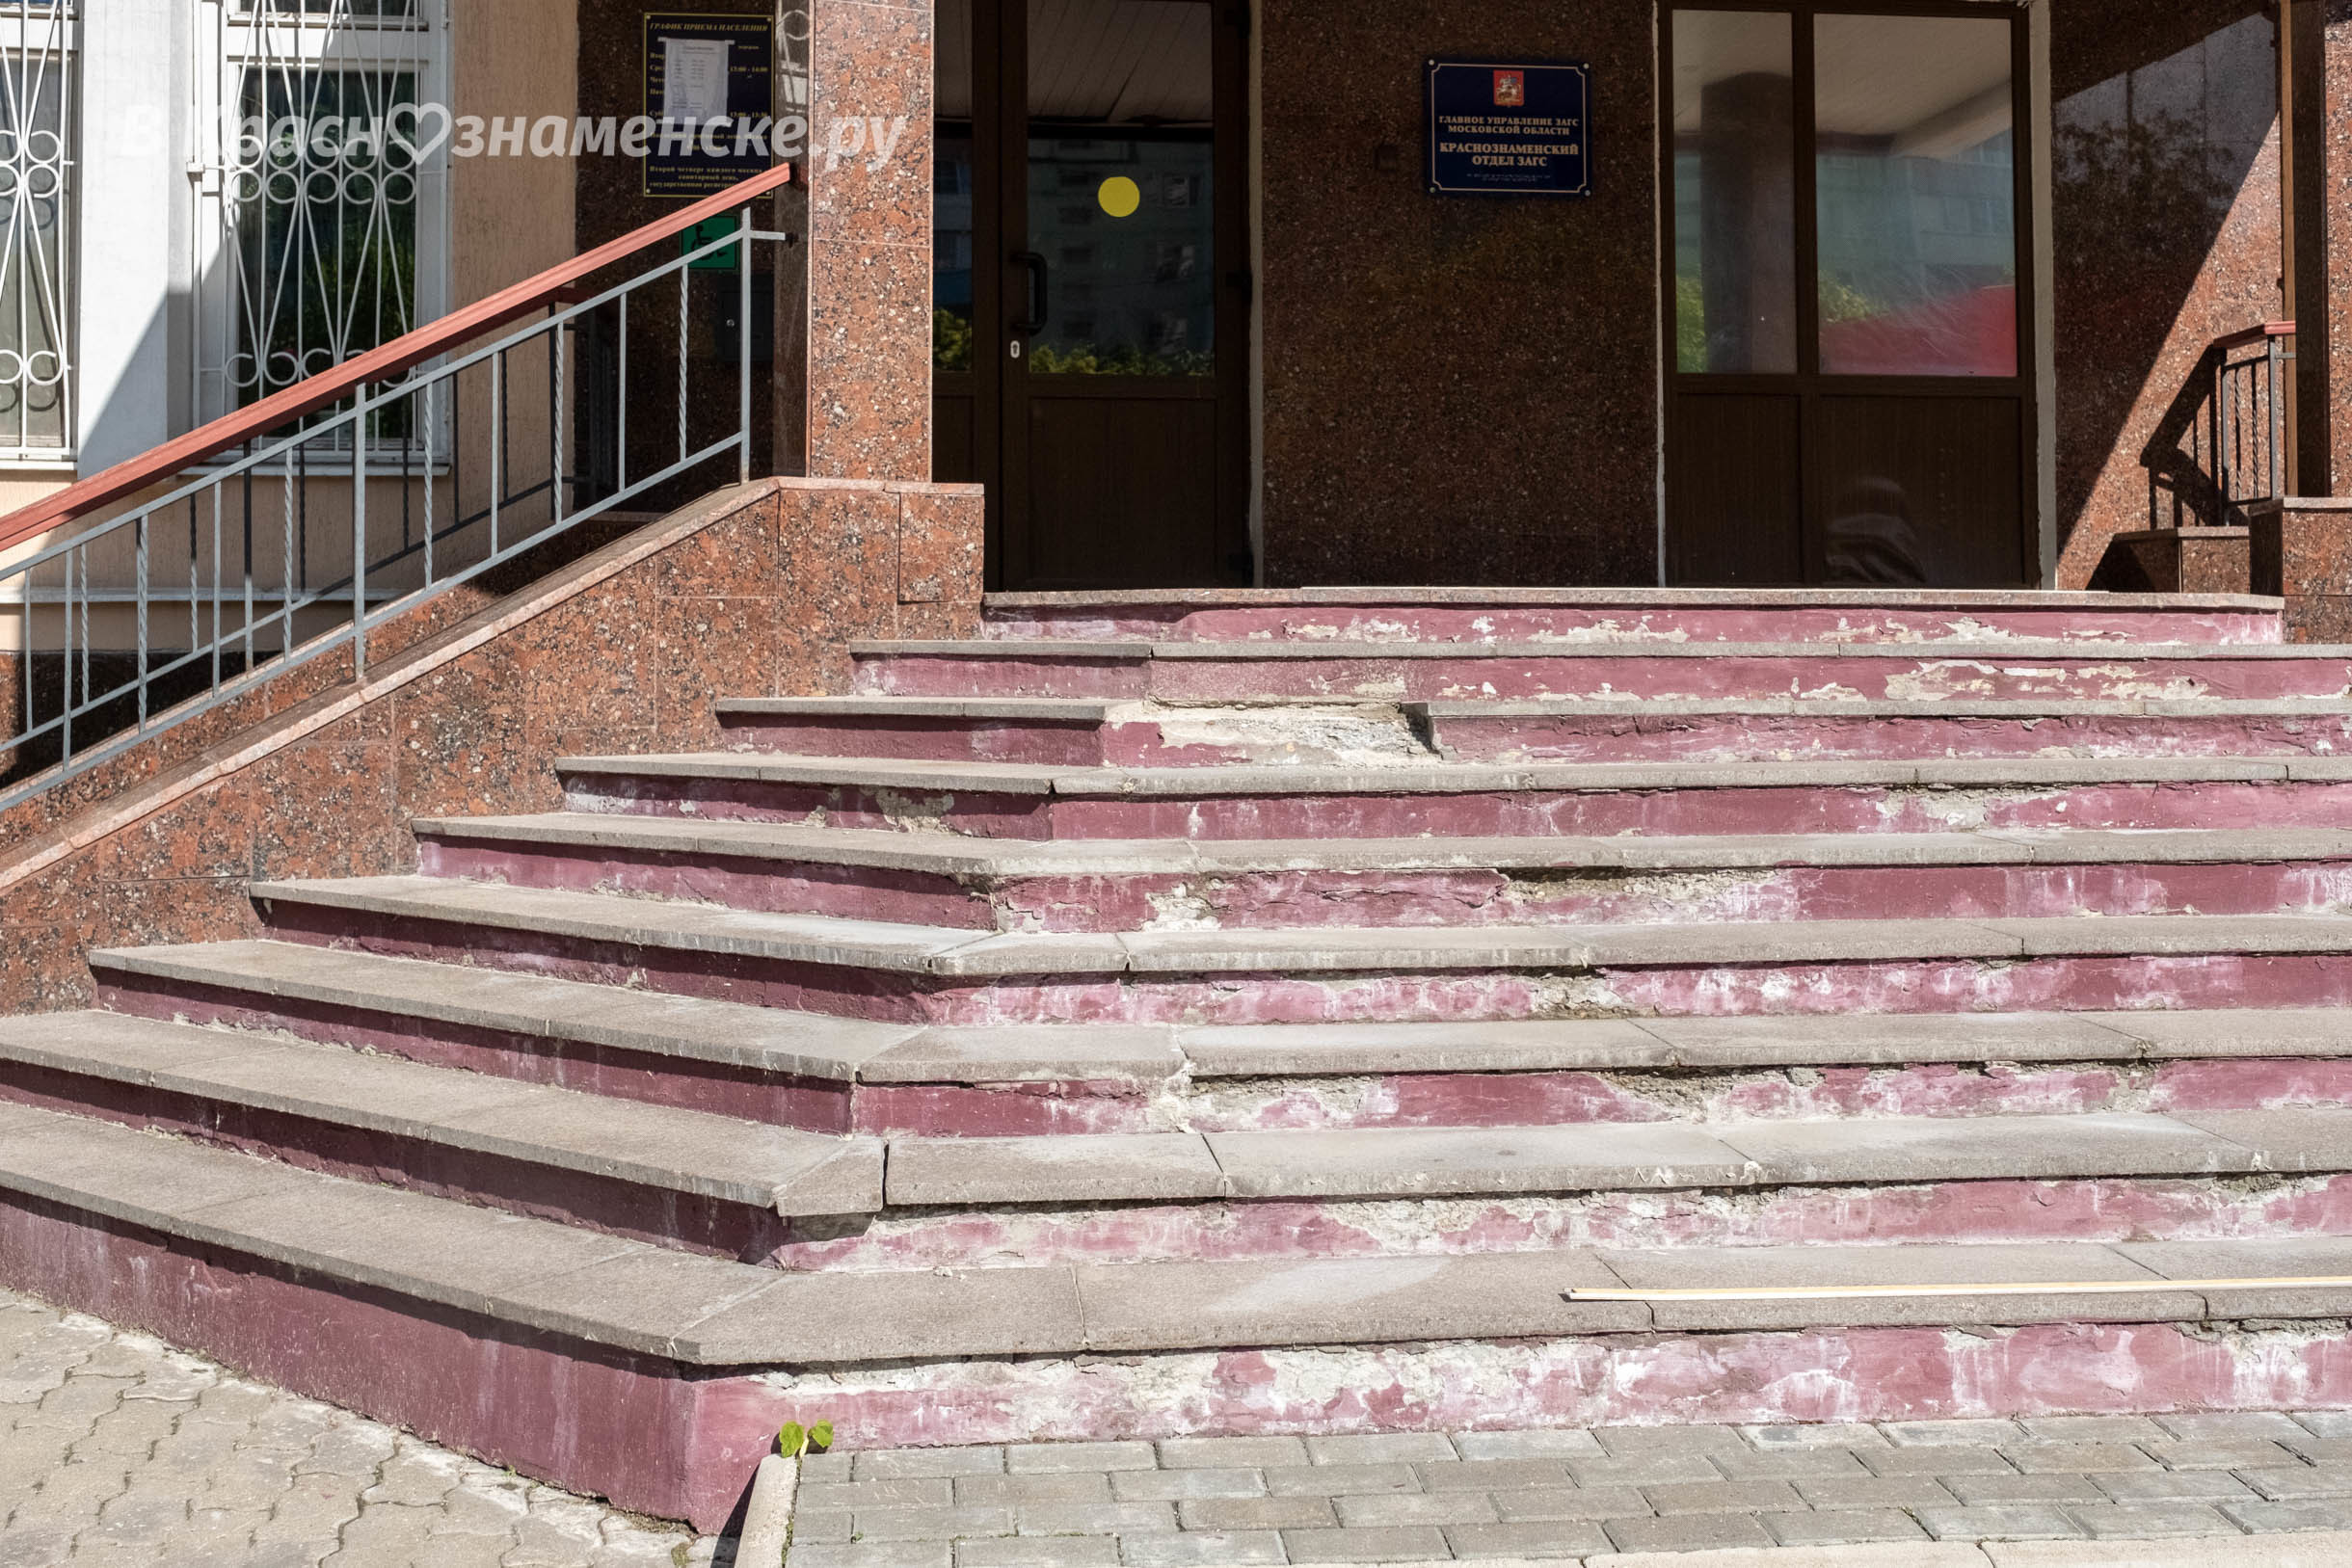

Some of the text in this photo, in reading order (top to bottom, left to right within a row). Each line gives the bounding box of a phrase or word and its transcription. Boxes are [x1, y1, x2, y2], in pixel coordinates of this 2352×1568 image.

[1438, 116, 1580, 127] ГЛАВНОЕ УПРАВЛЕНИЕ ЗАГС
[1448, 124, 1570, 136] МОСКОВСКОЙ ОБЛАСТИ
[1439, 142, 1580, 155] КРАСНОЗНАМЕНСКИЙ
[1472, 155, 1548, 167] ОТДЕЛ ЗАГС
